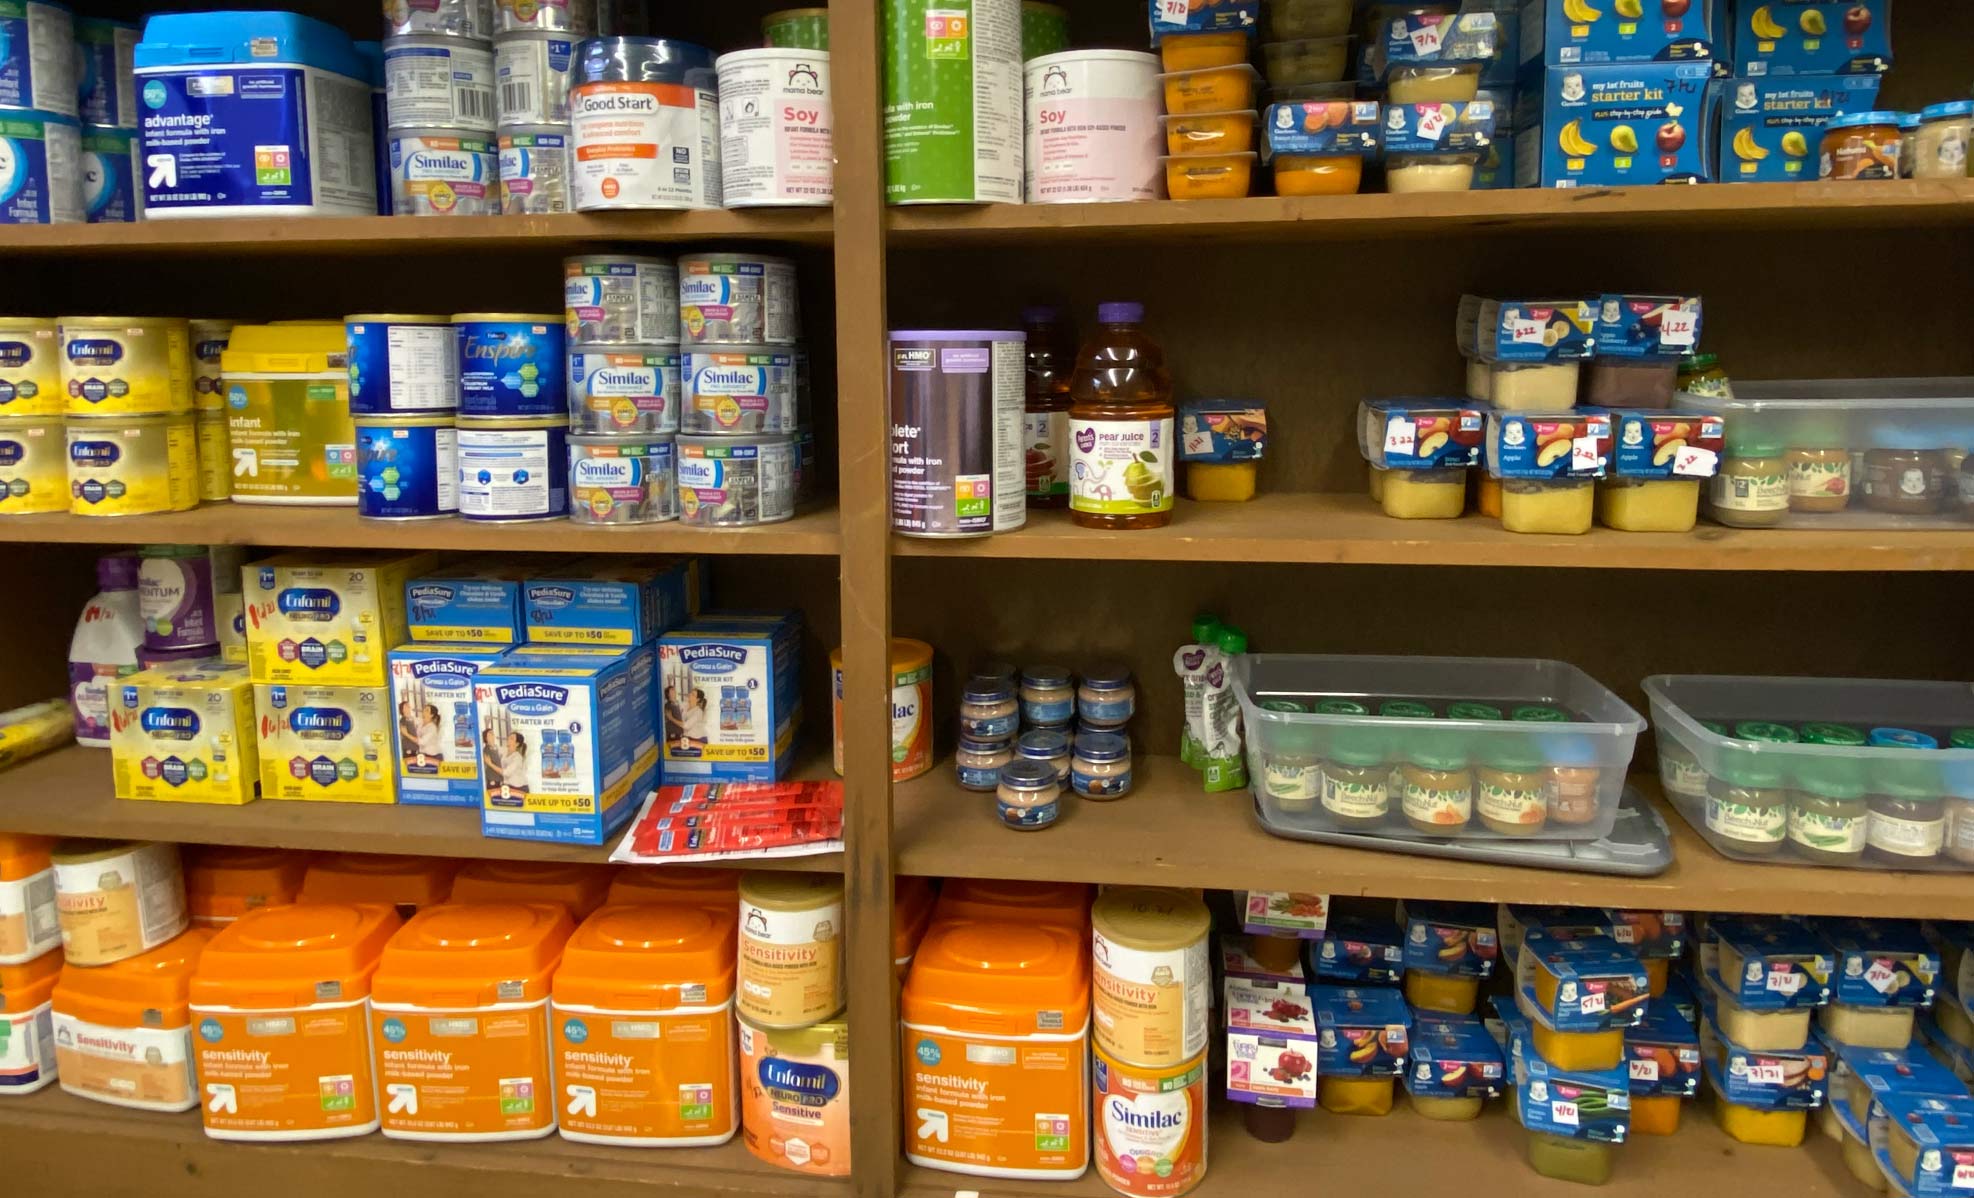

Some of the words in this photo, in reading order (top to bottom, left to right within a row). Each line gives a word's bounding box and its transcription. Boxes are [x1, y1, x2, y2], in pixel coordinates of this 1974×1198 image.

[783, 87, 806, 95] mama
[807, 87, 824, 96] bear
[1593, 83, 1605, 91] my
[1620, 80, 1645, 89] fruits
[1592, 90, 1640, 103] starter
[1644, 88, 1664, 101] kit
[1764, 93, 1777, 101] my
[1790, 91, 1814, 99] fruits
[584, 97, 615, 112] Good
[618, 96, 652, 110] Start
[896, 102, 913, 112] with
[915, 101, 934, 110] iron
[1763, 100, 1809, 111] starter
[1814, 98, 1832, 109] kit
[784, 107, 819, 125] Soy
[1040, 110, 1066, 124] Soy
[1610, 109, 1645, 119] step-by-step
[1645, 108, 1663, 119] guide
[145, 113, 211, 129] advantage
[194, 127, 209, 135] with
[210, 127, 226, 135] iron
[415, 154, 468, 170] Similac
[72, 344, 114, 356] Enfamil
[909, 352, 929, 360] HMO
[599, 371, 650, 386] Similac
[704, 370, 753, 386] Similac
[230, 416, 261, 428] infant
[1039, 423, 1047, 433] 2
[1099, 433, 1120, 441] Pear
[1121, 431, 1144, 441] Juice
[1152, 432, 1159, 443] 2
[908, 456, 924, 465] with
[1503, 454, 1521, 463] Apple
[1620, 453, 1638, 462] Apple
[579, 463, 626, 476] Similac
[899, 467, 925, 475] powder
[349, 572, 364, 582] 20
[412, 586, 452, 598] PediaSure
[531, 588, 571, 599] PediaSure
[286, 594, 332, 608] Enfamil
[467, 630, 483, 638] $50
[574, 631, 585, 639] TO
[586, 631, 602, 639] $50
[683, 647, 742, 661] PediaSure
[415, 661, 474, 676] PediaSure
[425, 678, 444, 686] Grow
[448, 678, 465, 686] Gain
[207, 693, 222, 703] 20
[360, 692, 374, 701] 20
[426, 691, 454, 699] STARTER
[501, 685, 564, 701] PediaSure
[511, 703, 529, 711] Grow
[536, 704, 554, 712] Gain
[148, 712, 192, 727] Enfamil
[298, 713, 342, 727] Enfamil
[706, 749, 724, 757] SAVE
[726, 749, 735, 757] UP
[737, 749, 747, 757] TO
[749, 748, 765, 757] $50
[501, 785, 510, 799] 8
[528, 798, 546, 806] SAVE
[548, 799, 559, 807] UP
[561, 799, 571, 807] TO
[573, 797, 591, 807] $50
[743, 940, 817, 961] Sensitivity
[565, 1025, 588, 1036] 45%
[77, 1033, 136, 1054] Sensitivity
[202, 1049, 269, 1065] sensitivity
[383, 1049, 450, 1064] sensitivity
[564, 1050, 631, 1068] sensitivity
[917, 1048, 940, 1059] 45%
[768, 1064, 826, 1090] Enfamil
[915, 1071, 987, 1092] sensitivity
[1163, 1082, 1173, 1090] NO
[916, 1085, 937, 1095] infant
[940, 1088, 969, 1099] formula
[971, 1091, 988, 1101] with
[990, 1094, 1006, 1102] iron
[916, 1094, 957, 1105] milk-based
[959, 1100, 988, 1109] powder
[773, 1101, 822, 1119] Sensitive
[1112, 1100, 1182, 1129] Similac
